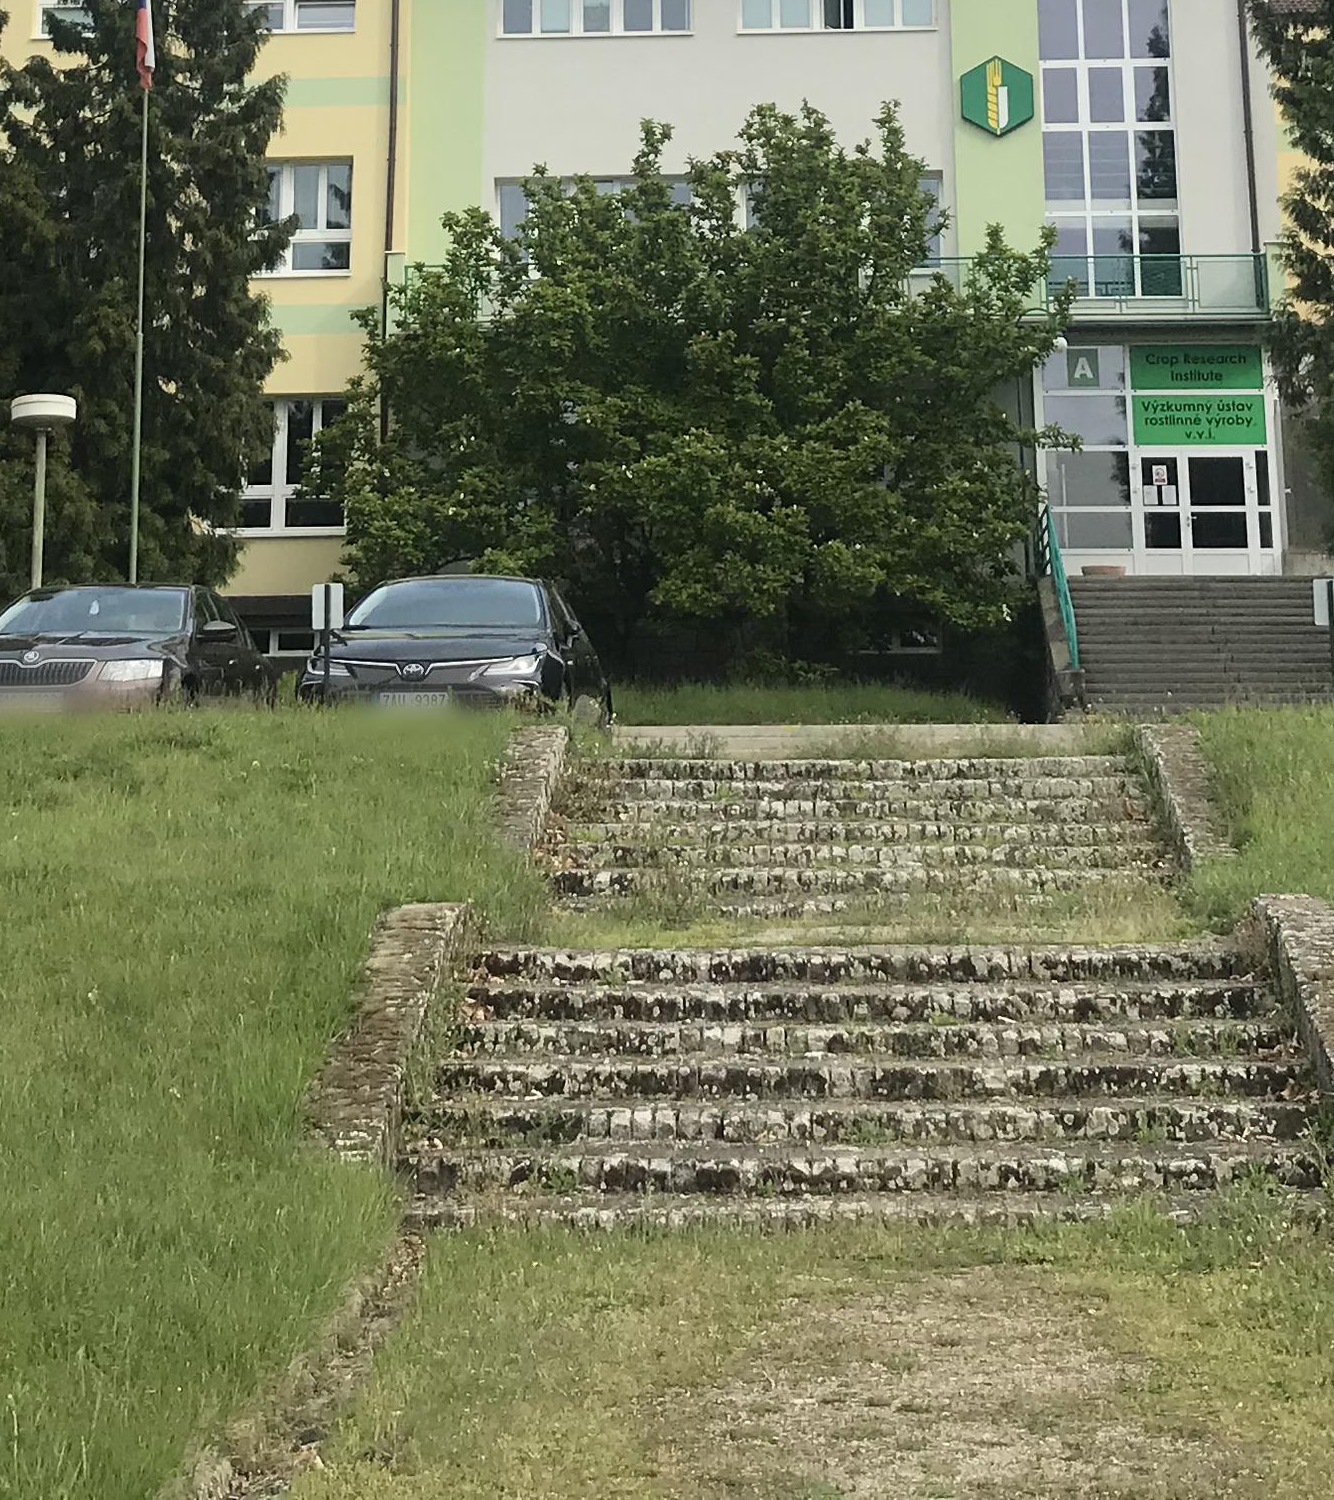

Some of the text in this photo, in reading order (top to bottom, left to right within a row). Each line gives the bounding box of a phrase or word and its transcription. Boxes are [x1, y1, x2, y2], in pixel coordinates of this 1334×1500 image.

[1145, 353, 1247, 366] Crop Research
[1074, 356, 1094, 379] A
[1170, 370, 1223, 381] Institute
[1141, 399, 1253, 414] Výzkumný ústav
[1144, 413, 1201, 426] rostlinné
